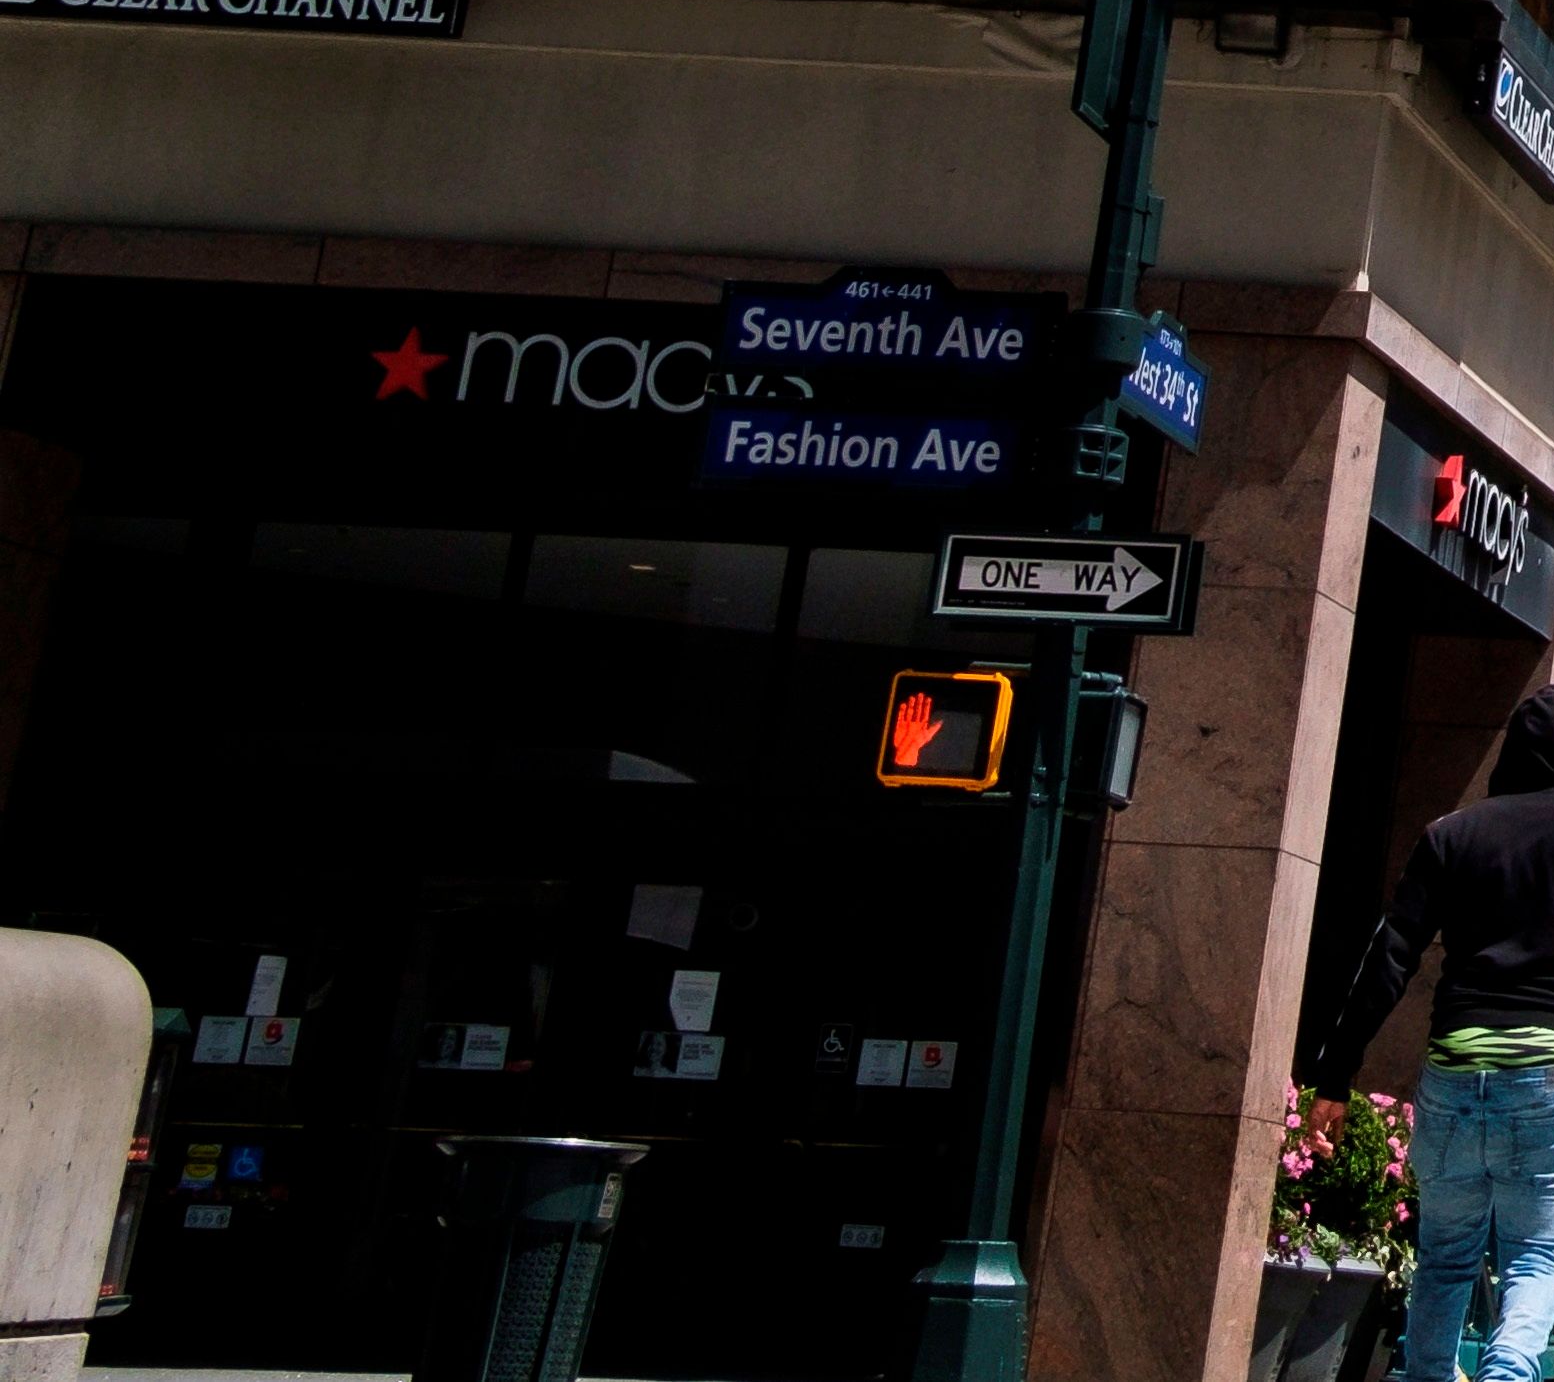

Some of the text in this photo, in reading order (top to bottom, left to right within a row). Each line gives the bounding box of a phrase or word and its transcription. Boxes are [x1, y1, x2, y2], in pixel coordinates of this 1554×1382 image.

[845, 281, 933, 301] 461 441
[738, 306, 1024, 361] Seventh Ave
[1183, 381, 1198, 426] St
[723, 421, 1001, 474] Fashion Ave
[1462, 468, 1529, 586] macy's
[981, 559, 1142, 593] ONE WAY
